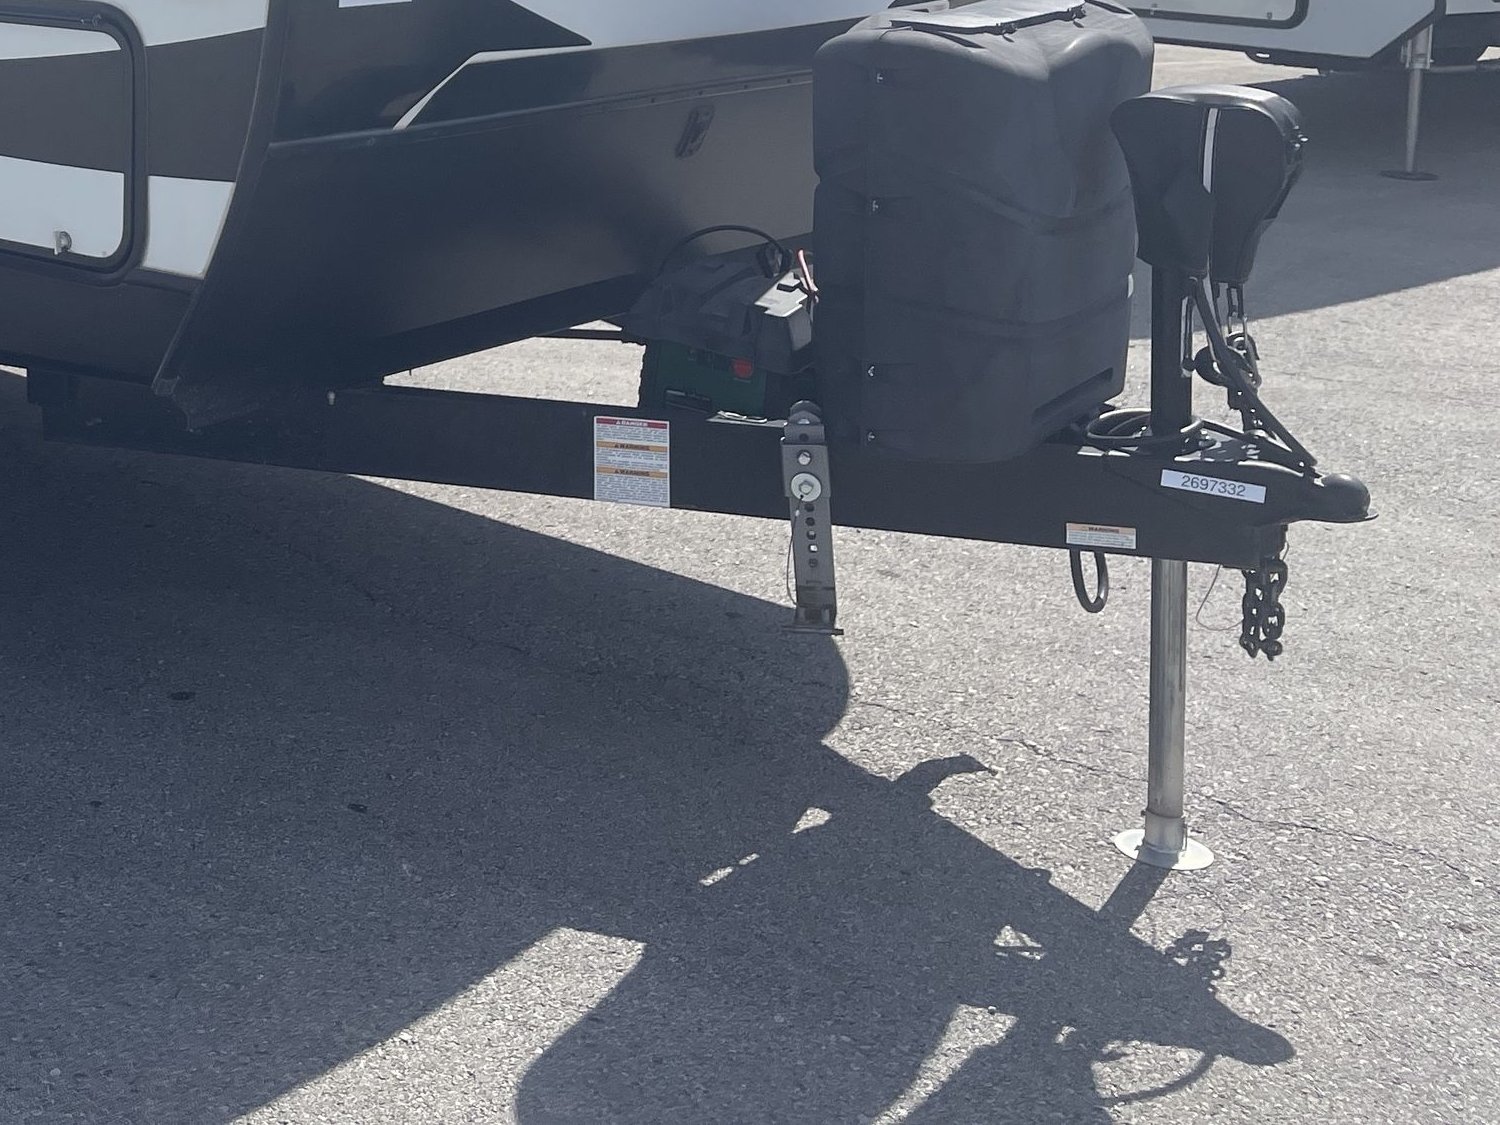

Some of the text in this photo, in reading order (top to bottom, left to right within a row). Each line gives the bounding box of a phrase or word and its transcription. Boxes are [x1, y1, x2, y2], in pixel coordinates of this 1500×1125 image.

[620, 443, 650, 451] WARNING
[620, 468, 650, 477] WARNING
[1180, 474, 1247, 497] 2697332
[1088, 526, 1120, 535] WARNING
